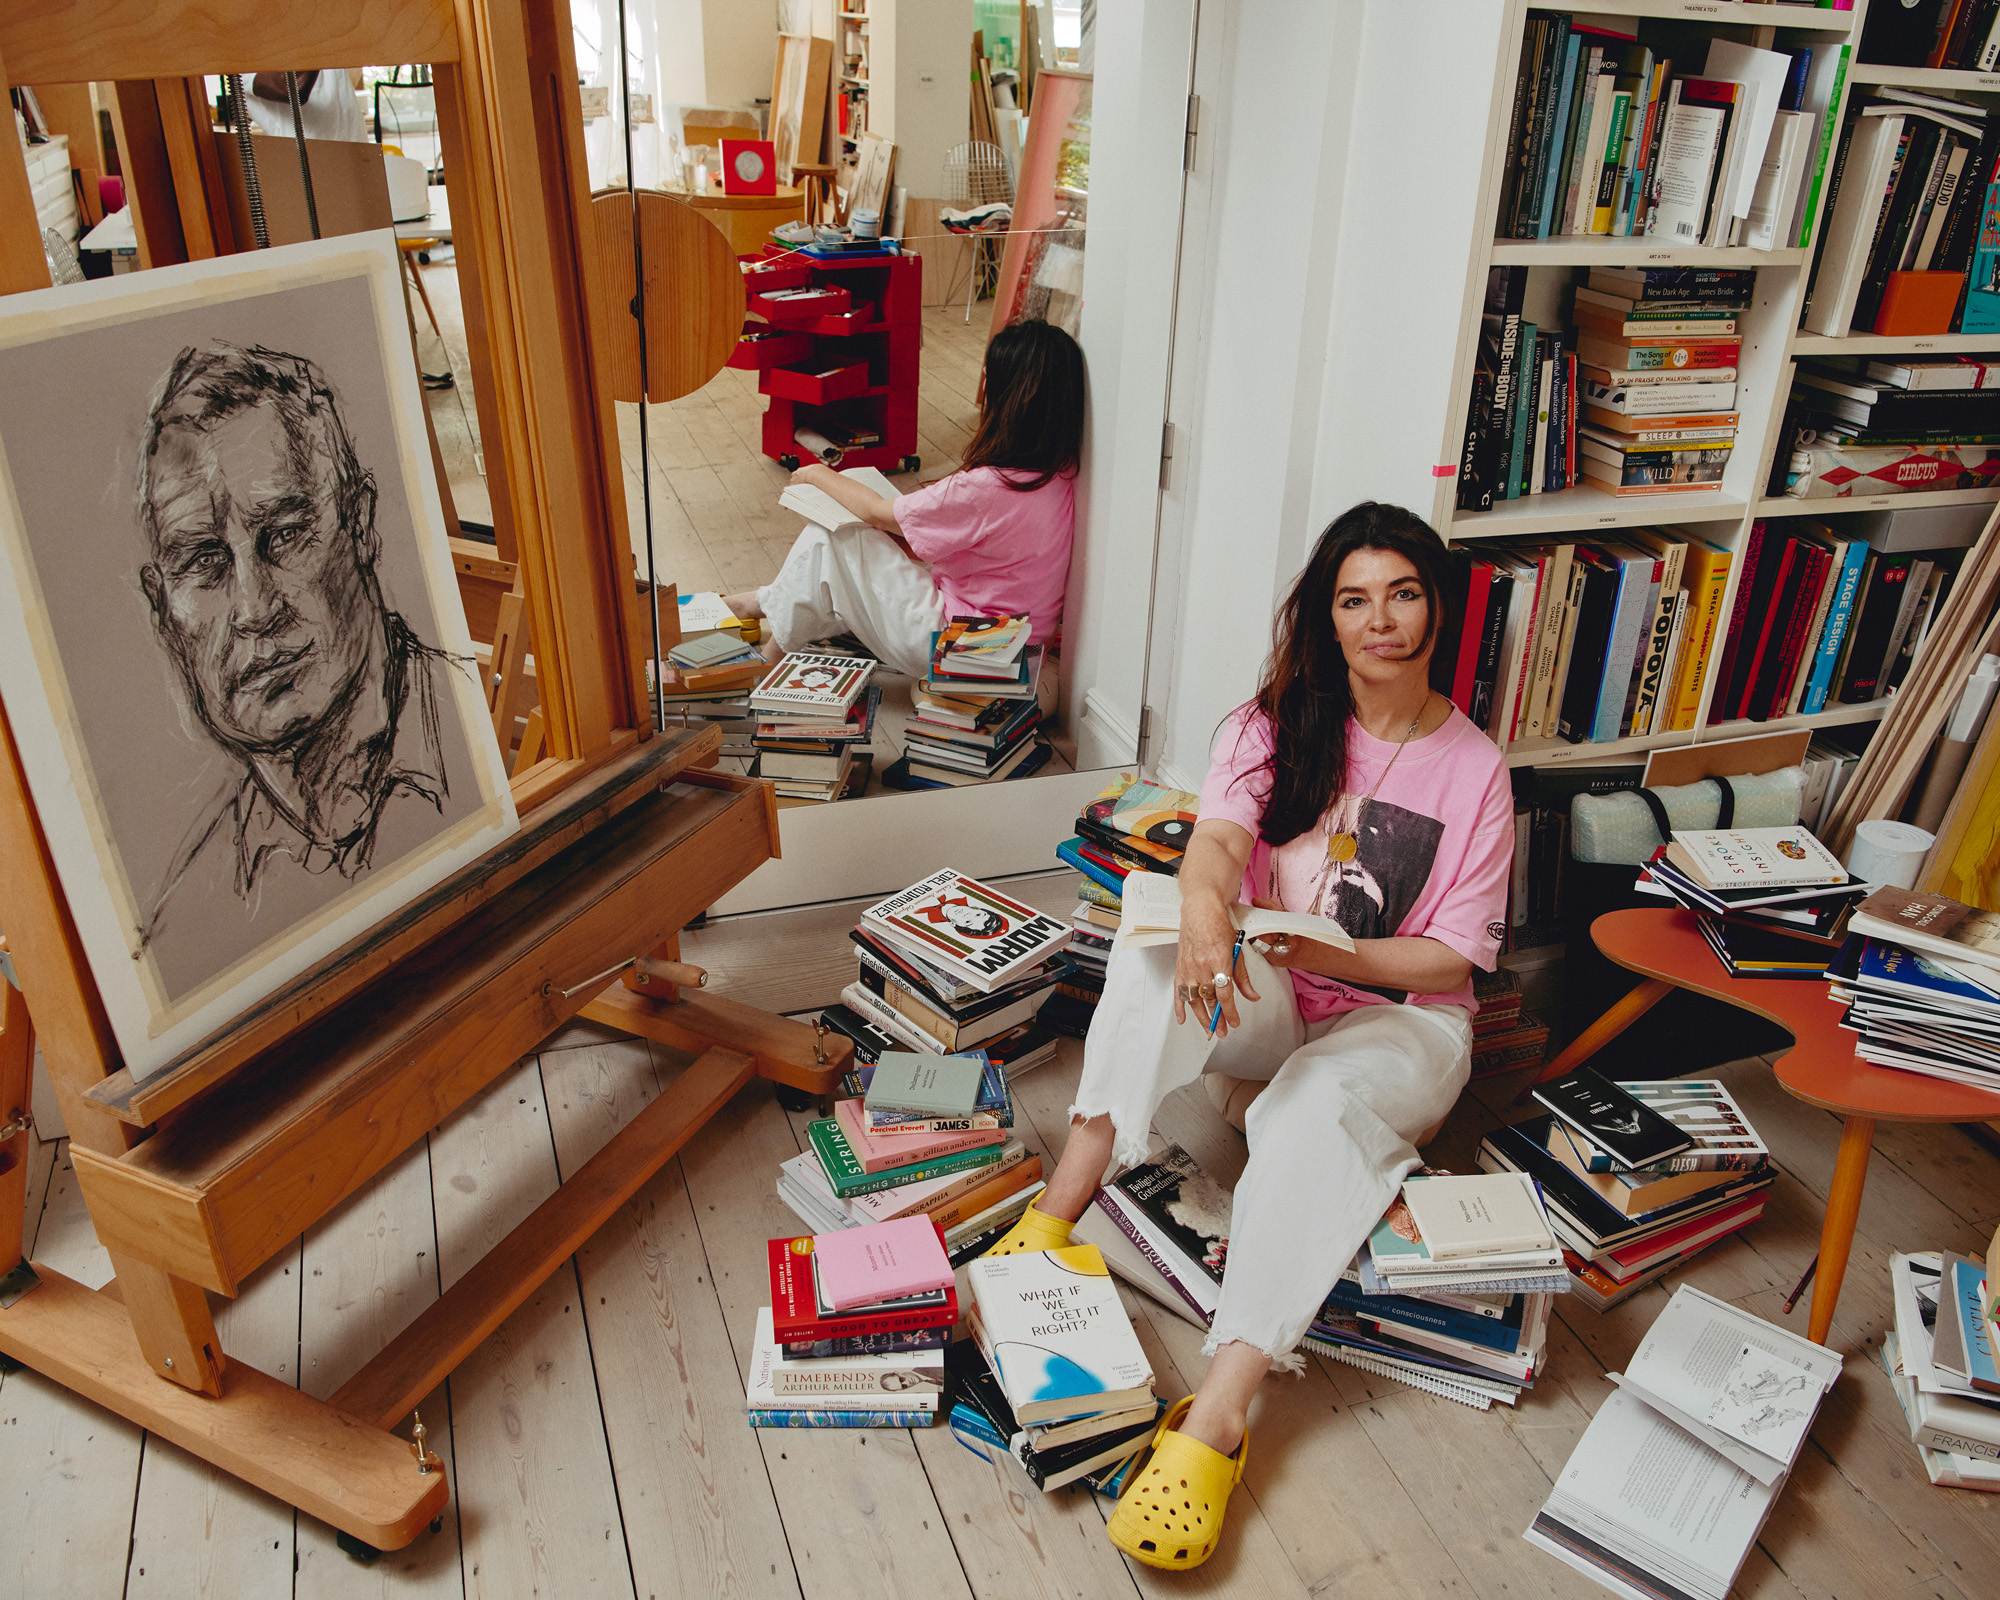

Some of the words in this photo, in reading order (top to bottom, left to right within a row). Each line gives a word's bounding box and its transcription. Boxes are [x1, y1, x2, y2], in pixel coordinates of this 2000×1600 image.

[1613, 99, 1627, 145] Destination
[1656, 100, 1667, 134] Takedown
[1610, 146, 1618, 159] Art
[1925, 175, 1940, 205] Nolde
[1937, 173, 1957, 207] COCTEAU
[1960, 155, 1983, 205] MASKS
[1647, 288, 1662, 296] New
[1662, 288, 1677, 296] Dark
[1677, 288, 1690, 298] Age
[1697, 288, 1717, 297] James
[1717, 287, 1735, 296] Bridle
[1500, 314, 1520, 360] INSIDE
[1501, 359, 1511, 374] THE
[1522, 338, 1534, 376] Knowledge
[1648, 351, 1664, 360] Song
[1493, 374, 1511, 410] BODY
[1510, 371, 1519, 393] Data
[1520, 382, 1530, 411] Beautiful
[1552, 377, 1560, 426] Visualization
[1526, 407, 1535, 445] CHANGED
[1645, 432, 1673, 441] SLEEP
[1463, 432, 1477, 481] CHAOS
[1499, 452, 1509, 470] Kirk
[1643, 467, 1675, 480] WILD
[1896, 462, 1939, 482] CIRCUS
[1838, 567, 1859, 609] STAGE
[1495, 605, 1503, 616] SO
[1708, 587, 1720, 619] GREAT
[1492, 616, 1501, 631] FAR
[1547, 605, 1557, 631] CHANEL
[1551, 601, 1562, 635] GABRIELLE
[1490, 631, 1499, 642] SO
[1826, 613, 1846, 655] DESIGN
[1631, 629, 1649, 668] Chicago
[1640, 596, 1675, 712] POPOVA
[1538, 646, 1549, 682] MANIFESTO
[1543, 650, 1554, 677] FASHION
[1691, 659, 1704, 693] ARTISTS
[1590, 780, 1614, 788] BRIAN
[1112, 841, 1138, 857] Conscious
[1705, 835, 1745, 874] STROKE
[1728, 833, 1772, 874] INSIGHT
[1132, 856, 1147, 868] Mind
[931, 870, 958, 889] EDEL
[870, 884, 933, 919] RODRIGUEZ
[1086, 891, 1101, 901] THE
[1898, 902, 1928, 919] HAN
[964, 915, 1066, 975] WORM
[860, 952, 913, 995] Enshittification
[856, 1046, 873, 1062] THE
[884, 1115, 902, 1124] Calm
[900, 1124, 925, 1132] Everett
[933, 1119, 971, 1132] JAMES
[826, 1123, 863, 1175] STRING
[884, 1155, 904, 1166] want
[922, 1143, 949, 1158] gillian
[949, 1136, 986, 1150] anderson
[965, 1166, 994, 1187] ROBERT
[996, 1152, 1022, 1170] HOOK
[1126, 1174, 1156, 1193] Twilight
[1153, 1167, 1163, 1179] of
[1169, 1153, 1190, 1168] Gods
[1669, 1157, 1698, 1173] FLESH
[844, 1179, 889, 1197] STRING
[1119, 1213, 1134, 1231] WHO
[1131, 1227, 1175, 1281] Wagner
[1382, 1265, 1405, 1274] Analytic
[1407, 1263, 1432, 1271] Idealism
[1443, 1261, 1468, 1269] Nutshell
[1019, 1288, 1064, 1302] WHAT
[1069, 1285, 1082, 1296] IF
[1042, 1300, 1067, 1311] WE
[1052, 1308, 1081, 1322] GET
[1087, 1306, 1100, 1317] IT
[1390, 1304, 1447, 1328] consciousness
[794, 1329, 814, 1337] COLLINS
[830, 1323, 866, 1334] GOOD
[873, 1320, 889, 1329] TO
[894, 1315, 937, 1326] GREAT
[1031, 1320, 1088, 1337] RIGHT?
[764, 1349, 772, 1363] of
[782, 1372, 875, 1383] TIMEBENDS
[782, 1383, 831, 1392] ARTHUR
[833, 1382, 875, 1390] MILLER
[776, 1400, 786, 1408] of
[787, 1401, 820, 1409] Strangers
